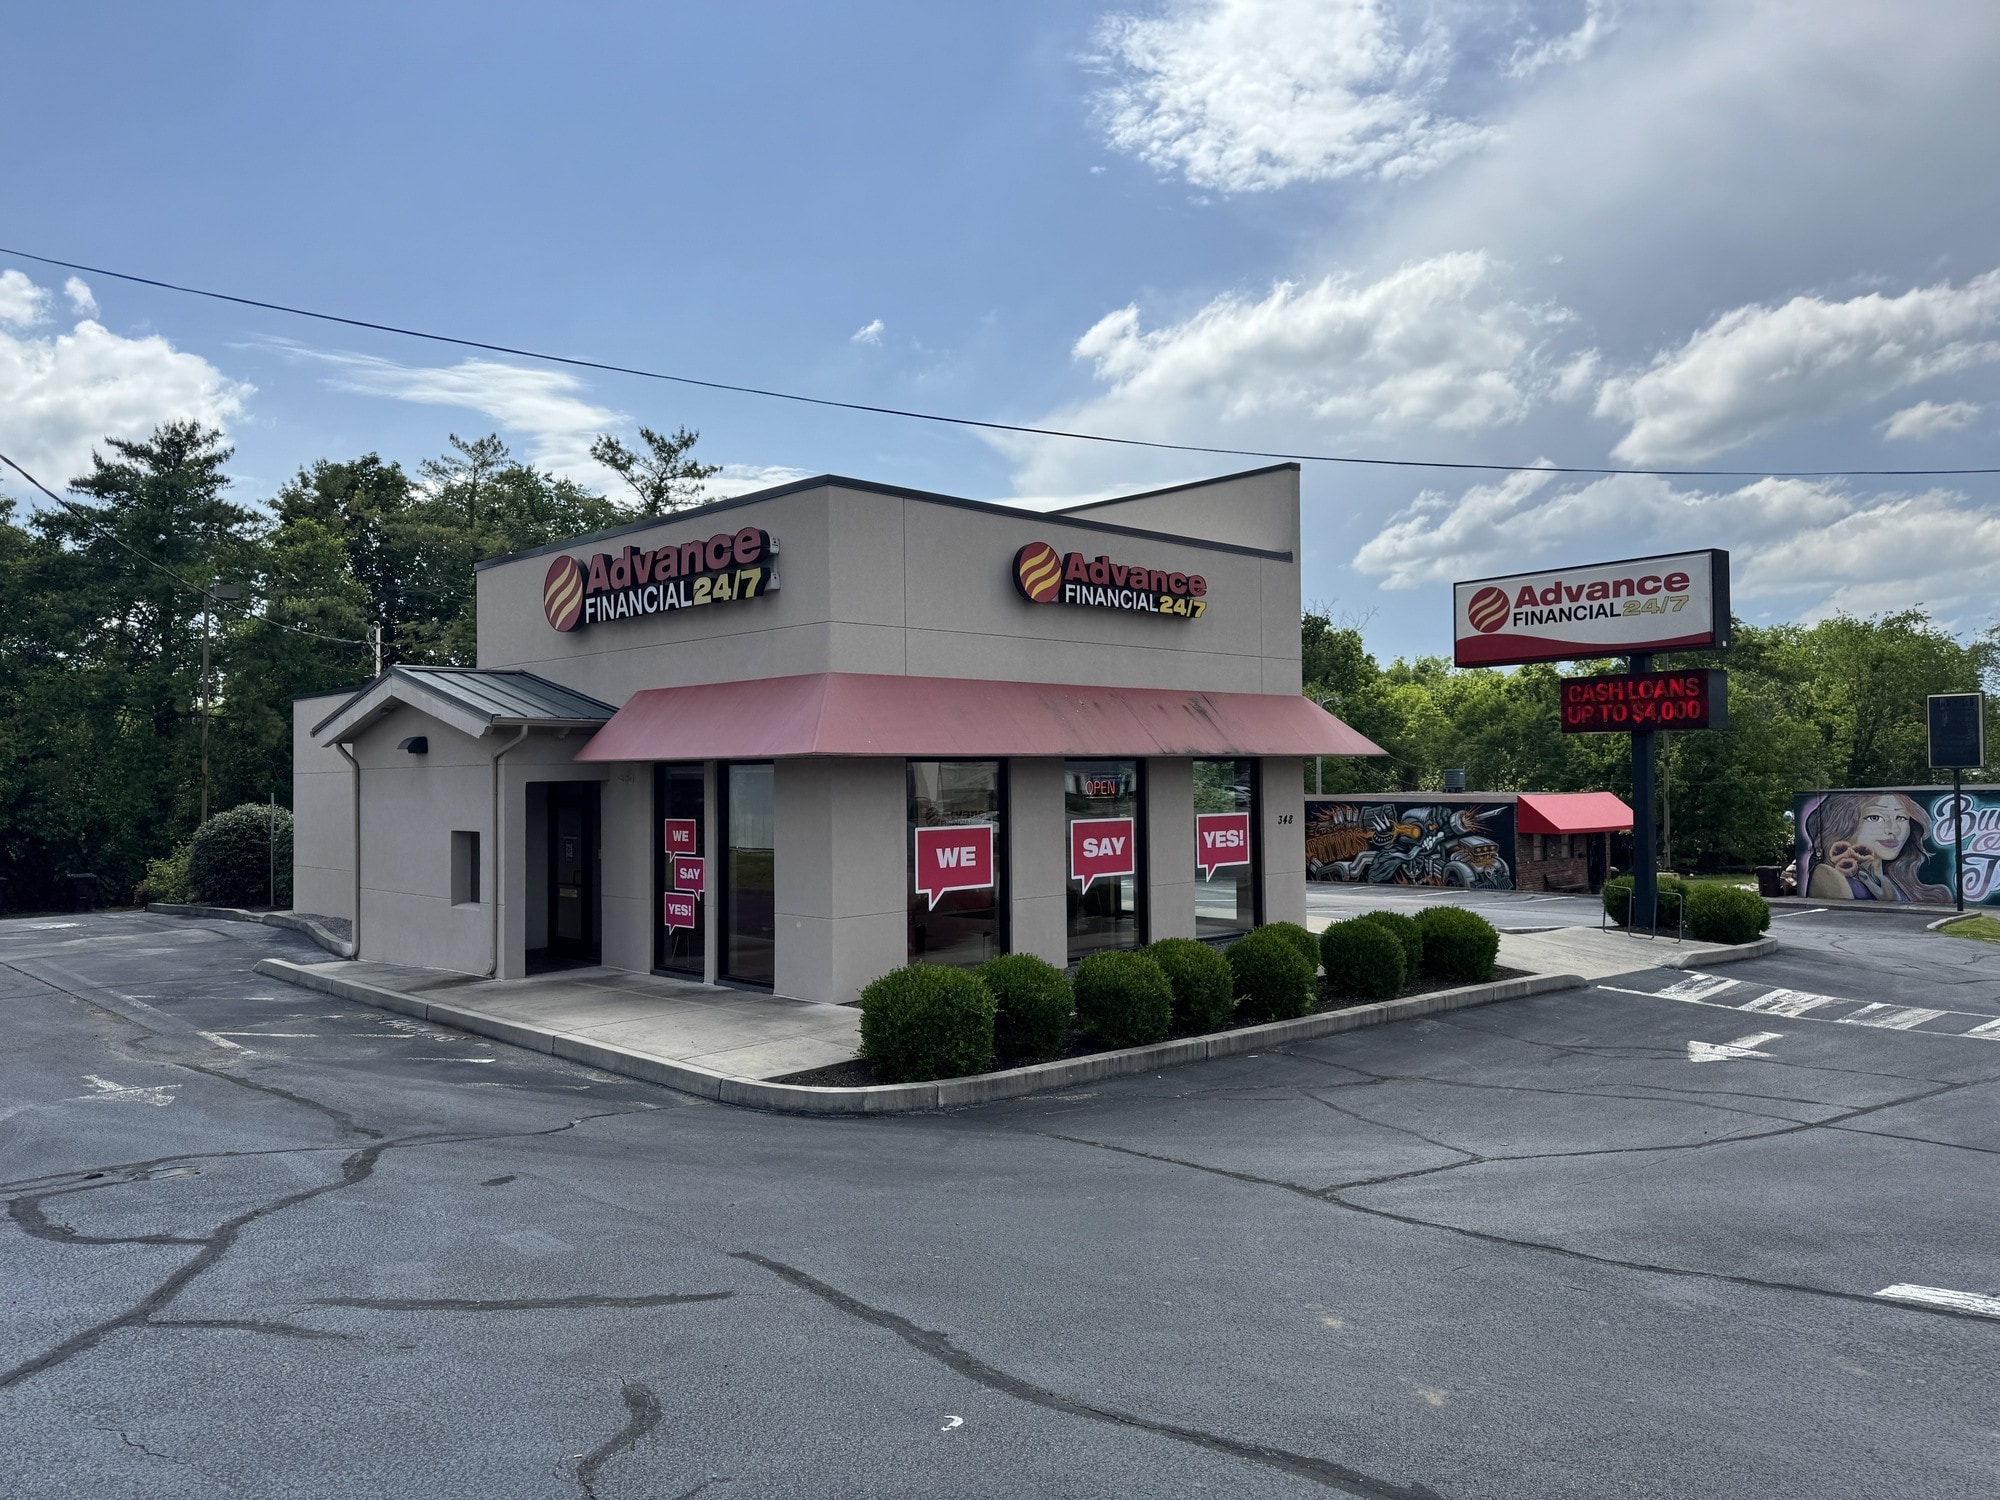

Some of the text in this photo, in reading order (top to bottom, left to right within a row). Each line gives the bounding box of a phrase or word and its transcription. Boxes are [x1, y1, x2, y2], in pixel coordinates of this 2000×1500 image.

[585, 527, 763, 595] Advance
[1064, 552, 1208, 597] Advance
[585, 567, 763, 624] FINANCIAL 24/7
[1065, 583, 1208, 618] FINANCIAL 24/7
[1513, 572, 1691, 609] Advance
[1512, 595, 1690, 627] FINANCIAL 24/7
[1567, 677, 1700, 703] CASH LOANS
[1567, 700, 1701, 724] UP TO $4,000
[1085, 780, 1117, 796] OPEN
[1277, 814, 1294, 825] 348
[672, 830, 690, 842] WE
[1082, 836, 1126, 858] SAY
[1202, 829, 1244, 849] YES!
[935, 845, 977, 869] WE
[679, 868, 701, 880] SAY
[668, 903, 692, 917] YES!
